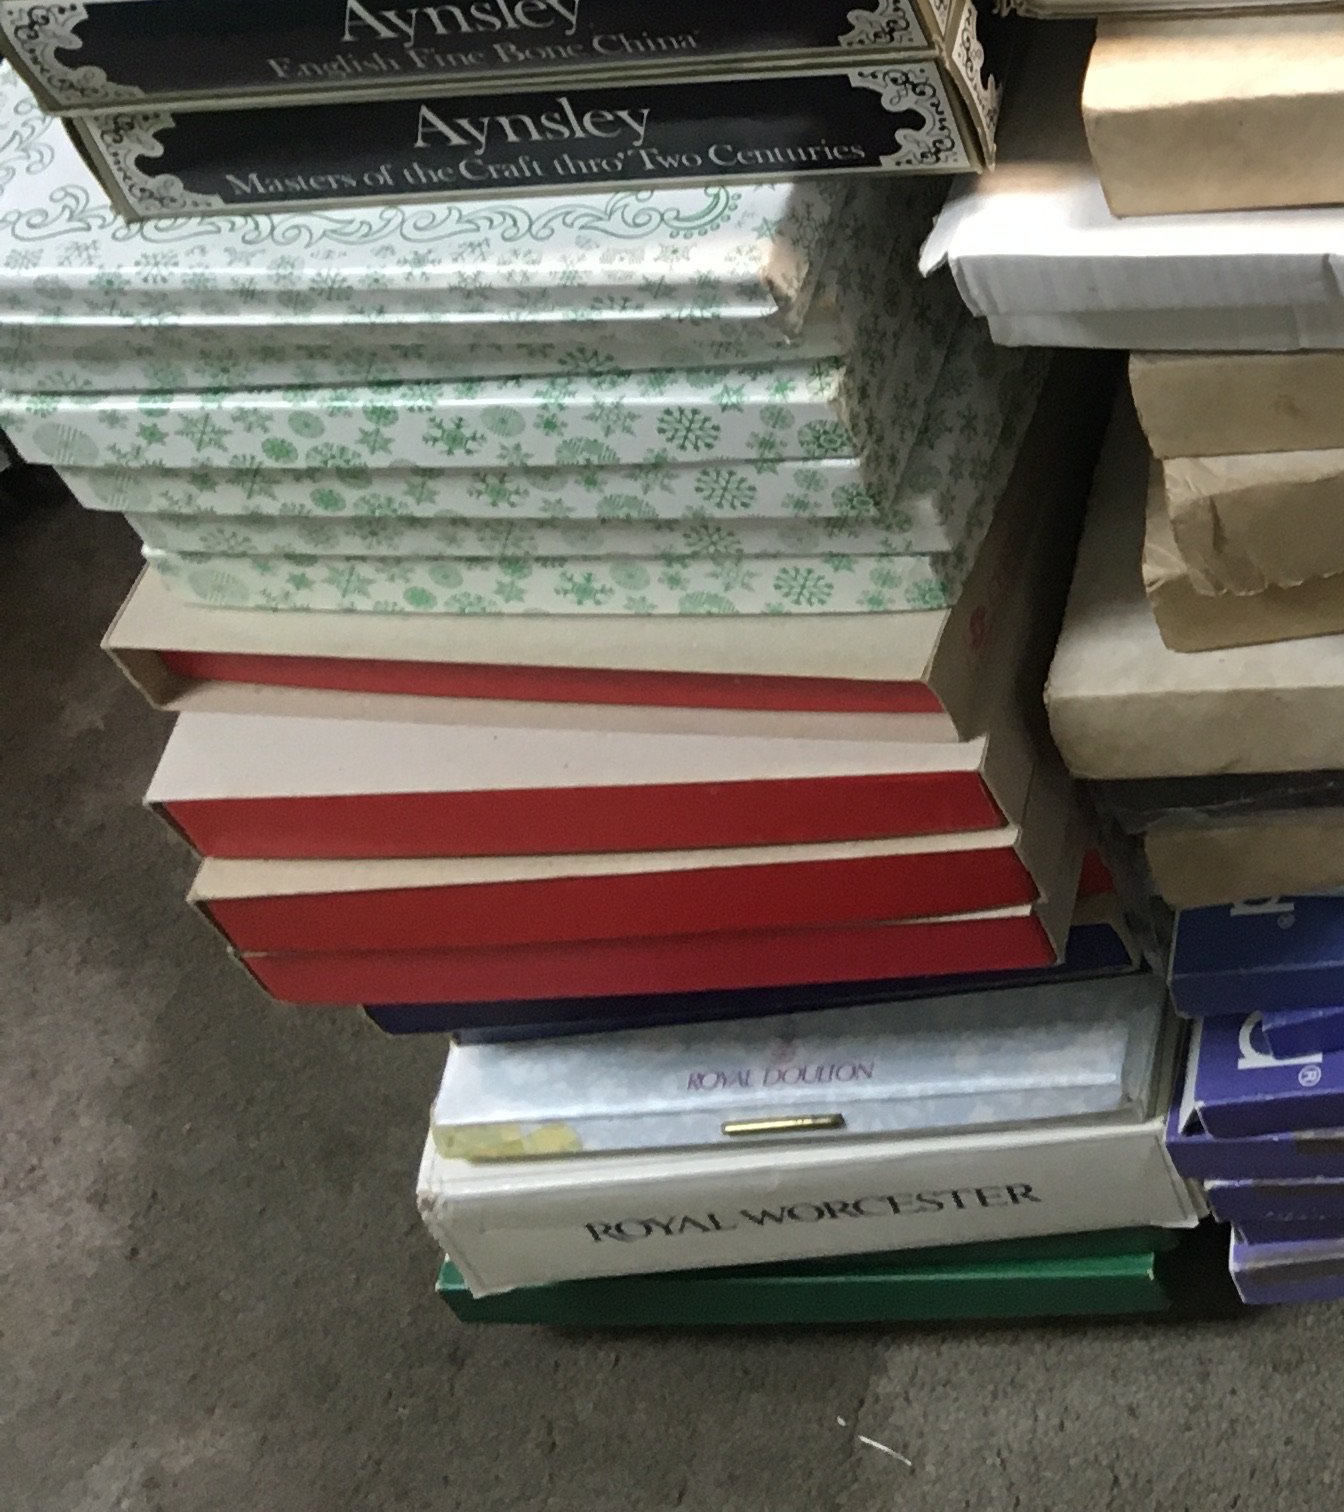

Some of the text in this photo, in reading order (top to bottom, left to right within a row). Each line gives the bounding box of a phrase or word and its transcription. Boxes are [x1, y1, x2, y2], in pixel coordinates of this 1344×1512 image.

[266, 49, 400, 80] English
[408, 44, 486, 70] Fine
[492, 40, 583, 65] Bone
[413, 96, 651, 156] Aynsley
[224, 139, 866, 198] Masters of the Craft thro' Two Centuries
[687, 1059, 875, 1090] ROYAL DOULTON
[584, 1183, 1042, 1243] ROYAL WORCESTER
